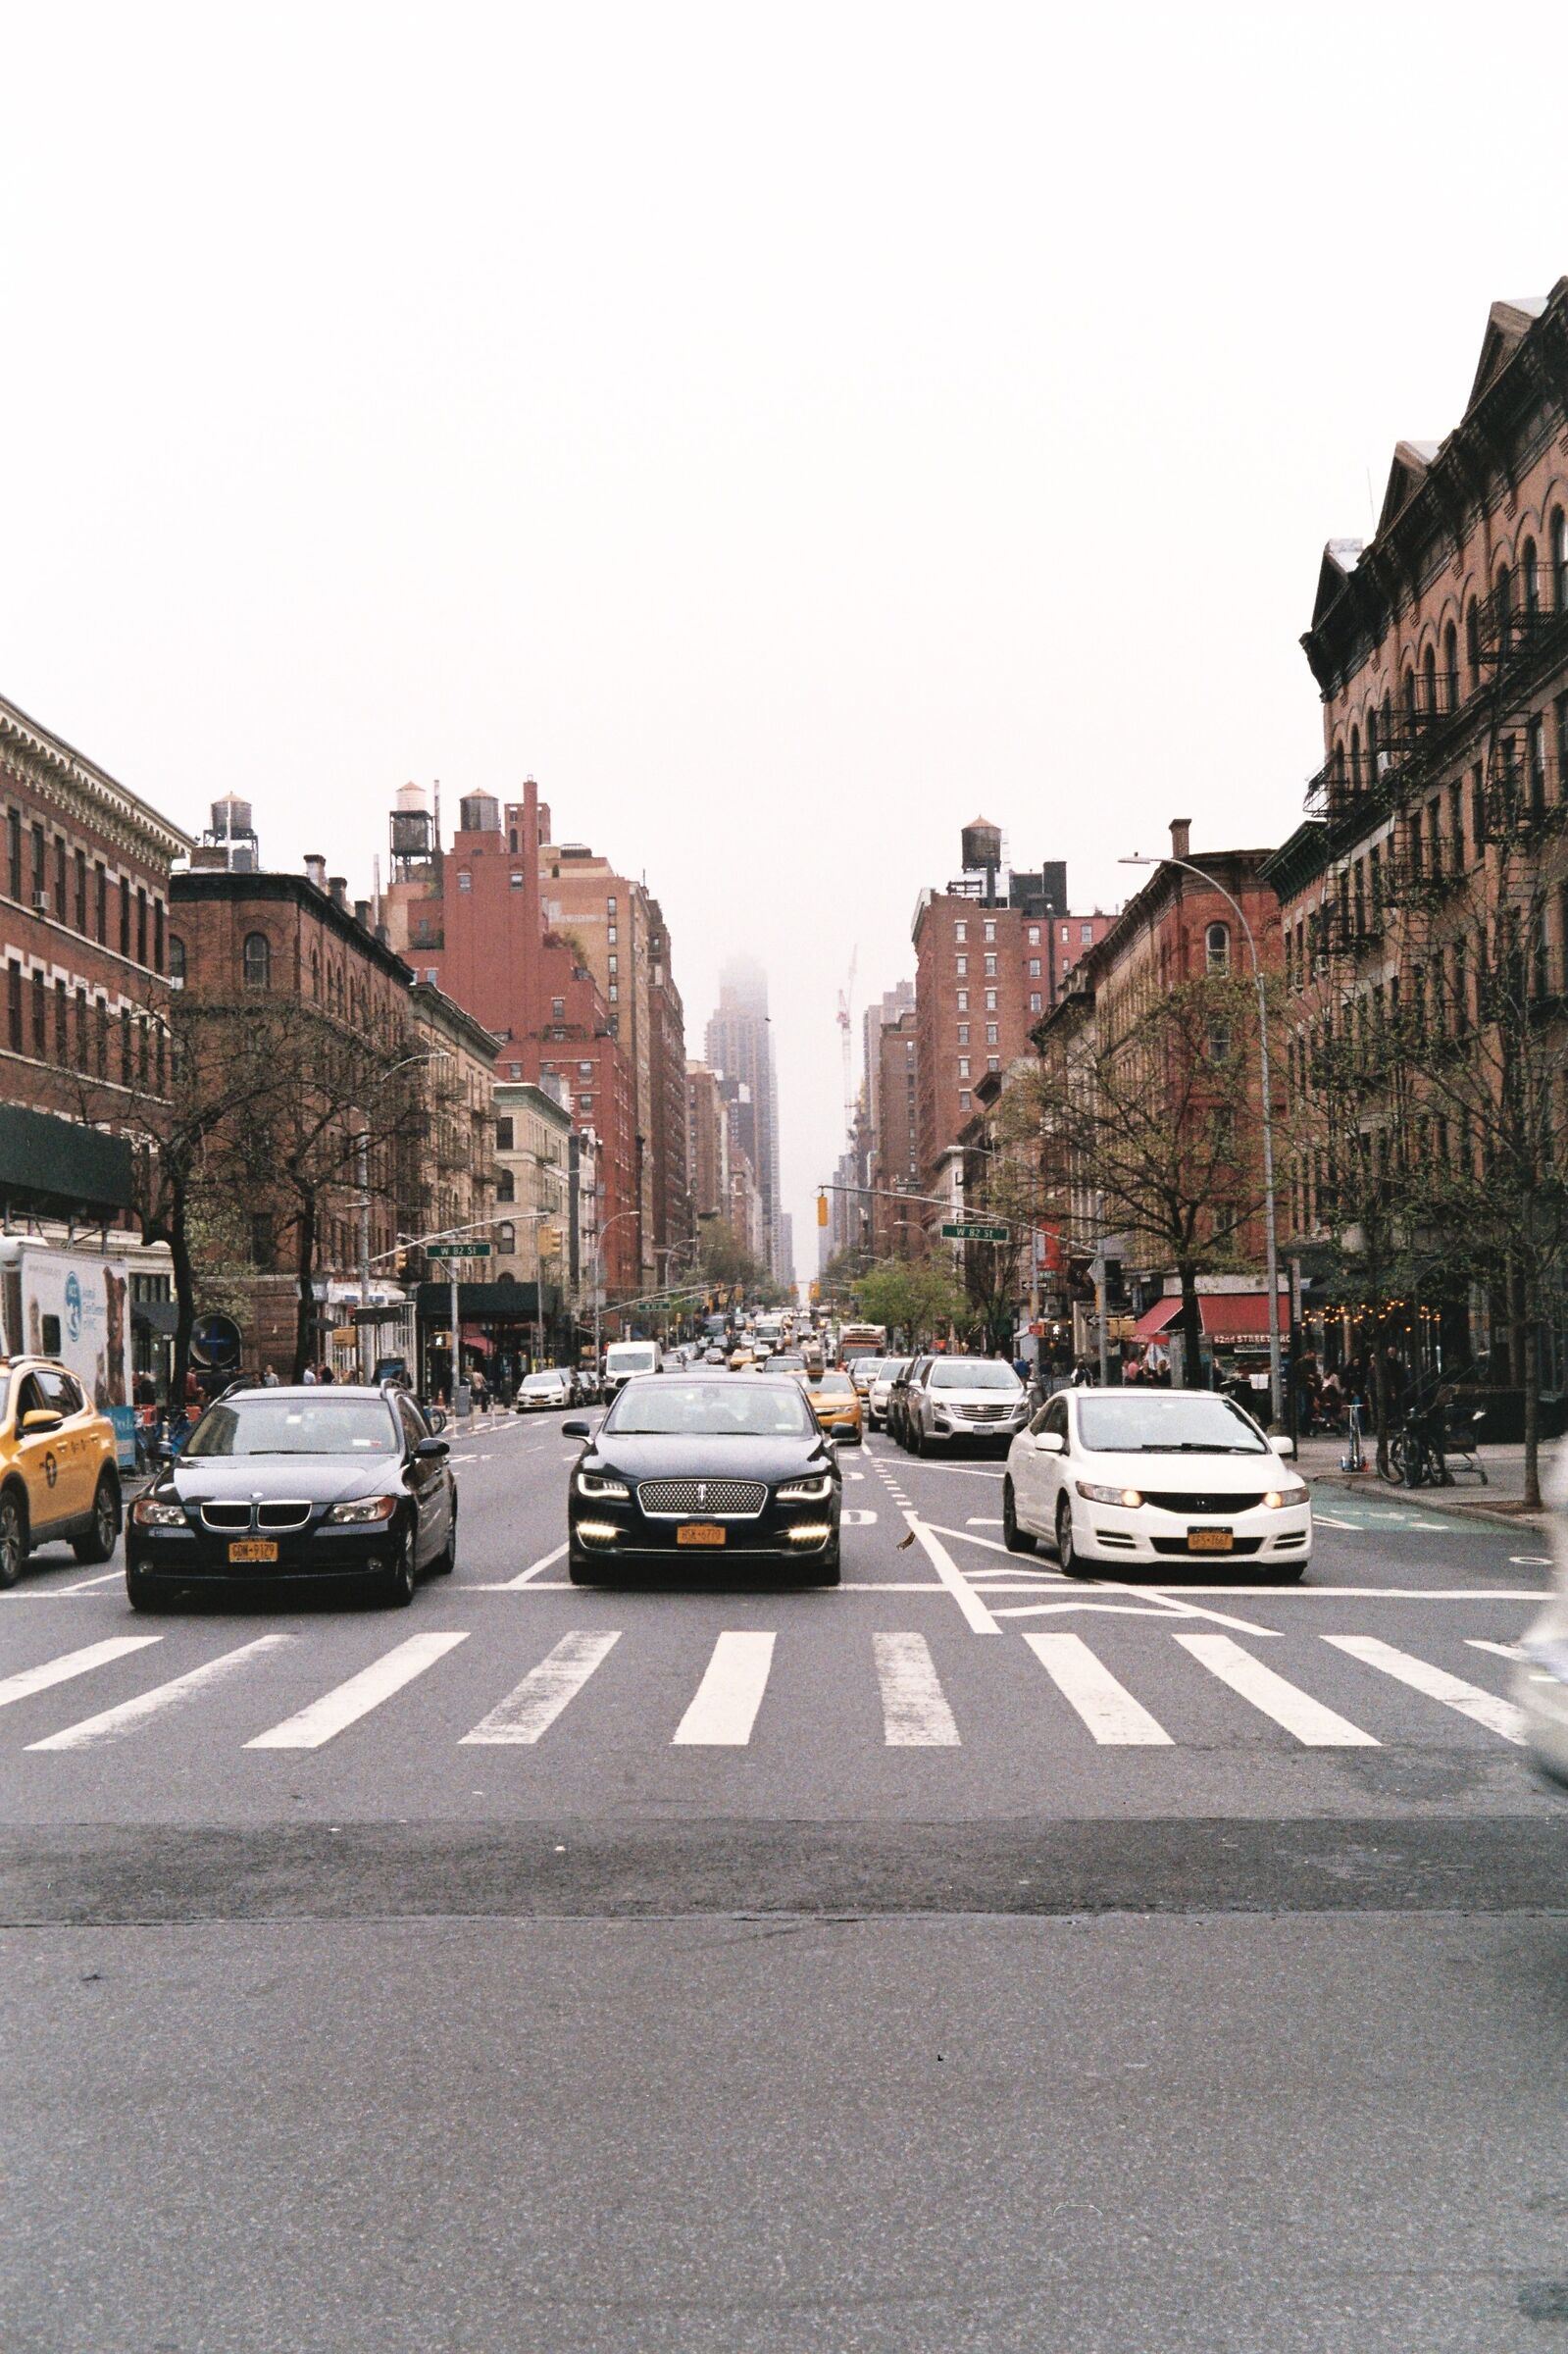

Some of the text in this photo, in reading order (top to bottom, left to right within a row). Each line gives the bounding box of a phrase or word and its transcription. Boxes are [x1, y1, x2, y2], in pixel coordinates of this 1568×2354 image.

[969, 1228, 980, 1237] 82
[984, 1229, 992, 1239] St
[440, 1246, 477, 1255] W 82 St
[1237, 1334, 1271, 1343] STREET
